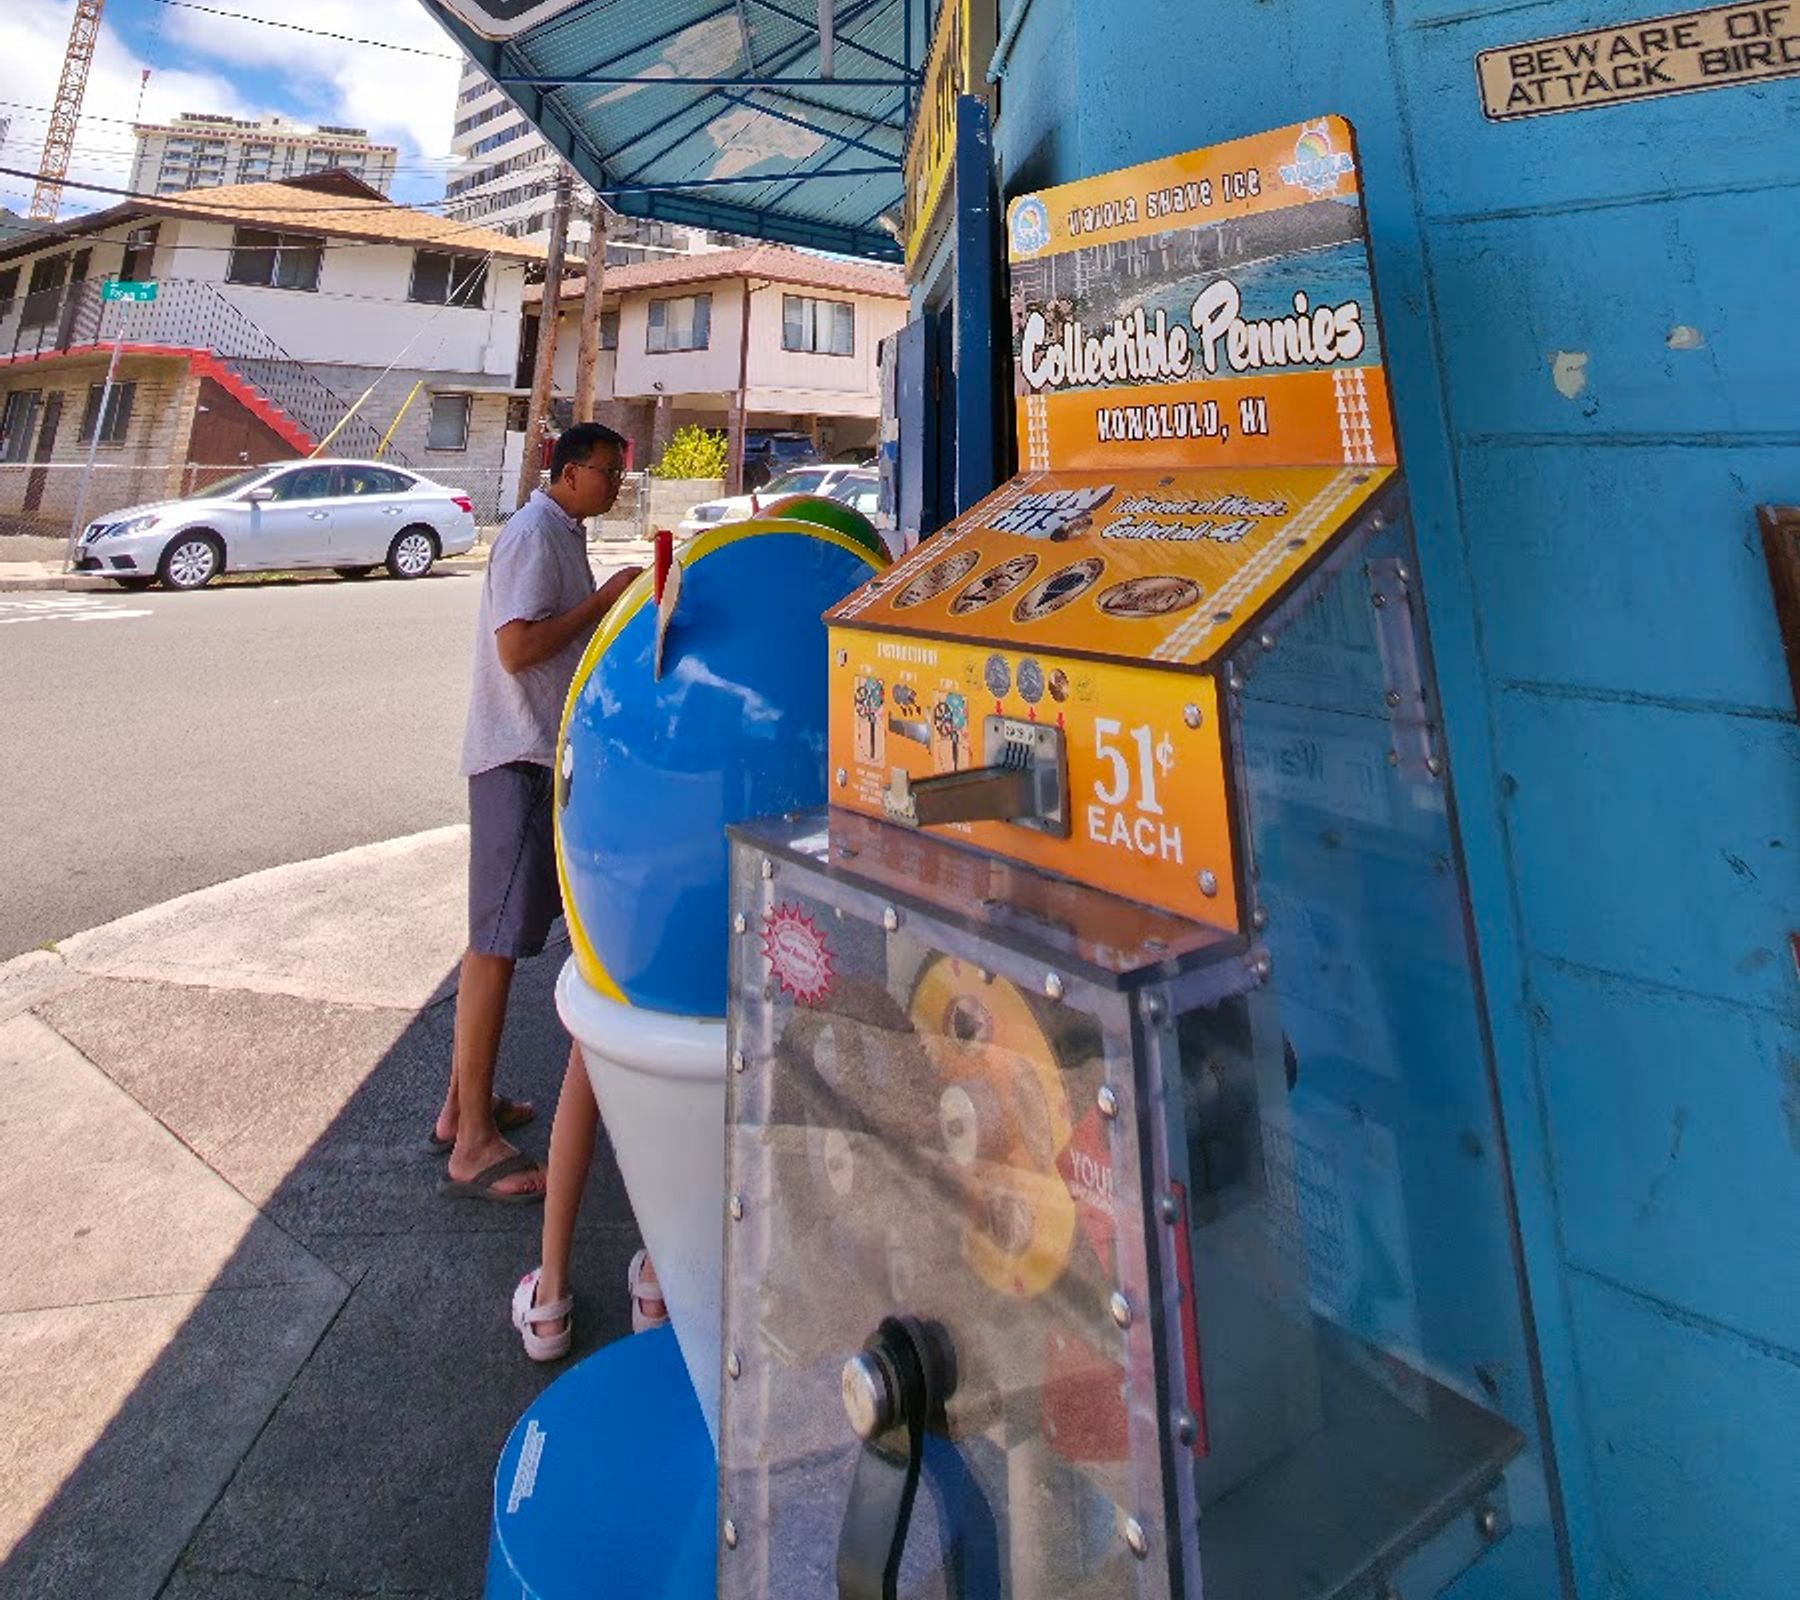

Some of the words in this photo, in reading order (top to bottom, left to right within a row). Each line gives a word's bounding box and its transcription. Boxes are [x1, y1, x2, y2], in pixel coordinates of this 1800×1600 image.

[1508, 21, 1702, 80] BEWARE
[1725, 4, 1791, 40] OF
[1506, 57, 1676, 110] ATTACK
[1022, 307, 1194, 389] Collectible
[1190, 278, 1365, 375] Pennies
[1238, 395, 1270, 436] HI
[1100, 514, 1183, 540] Collect
[1094, 717, 1175, 816] 51¢
[1087, 804, 1184, 865] EACH
